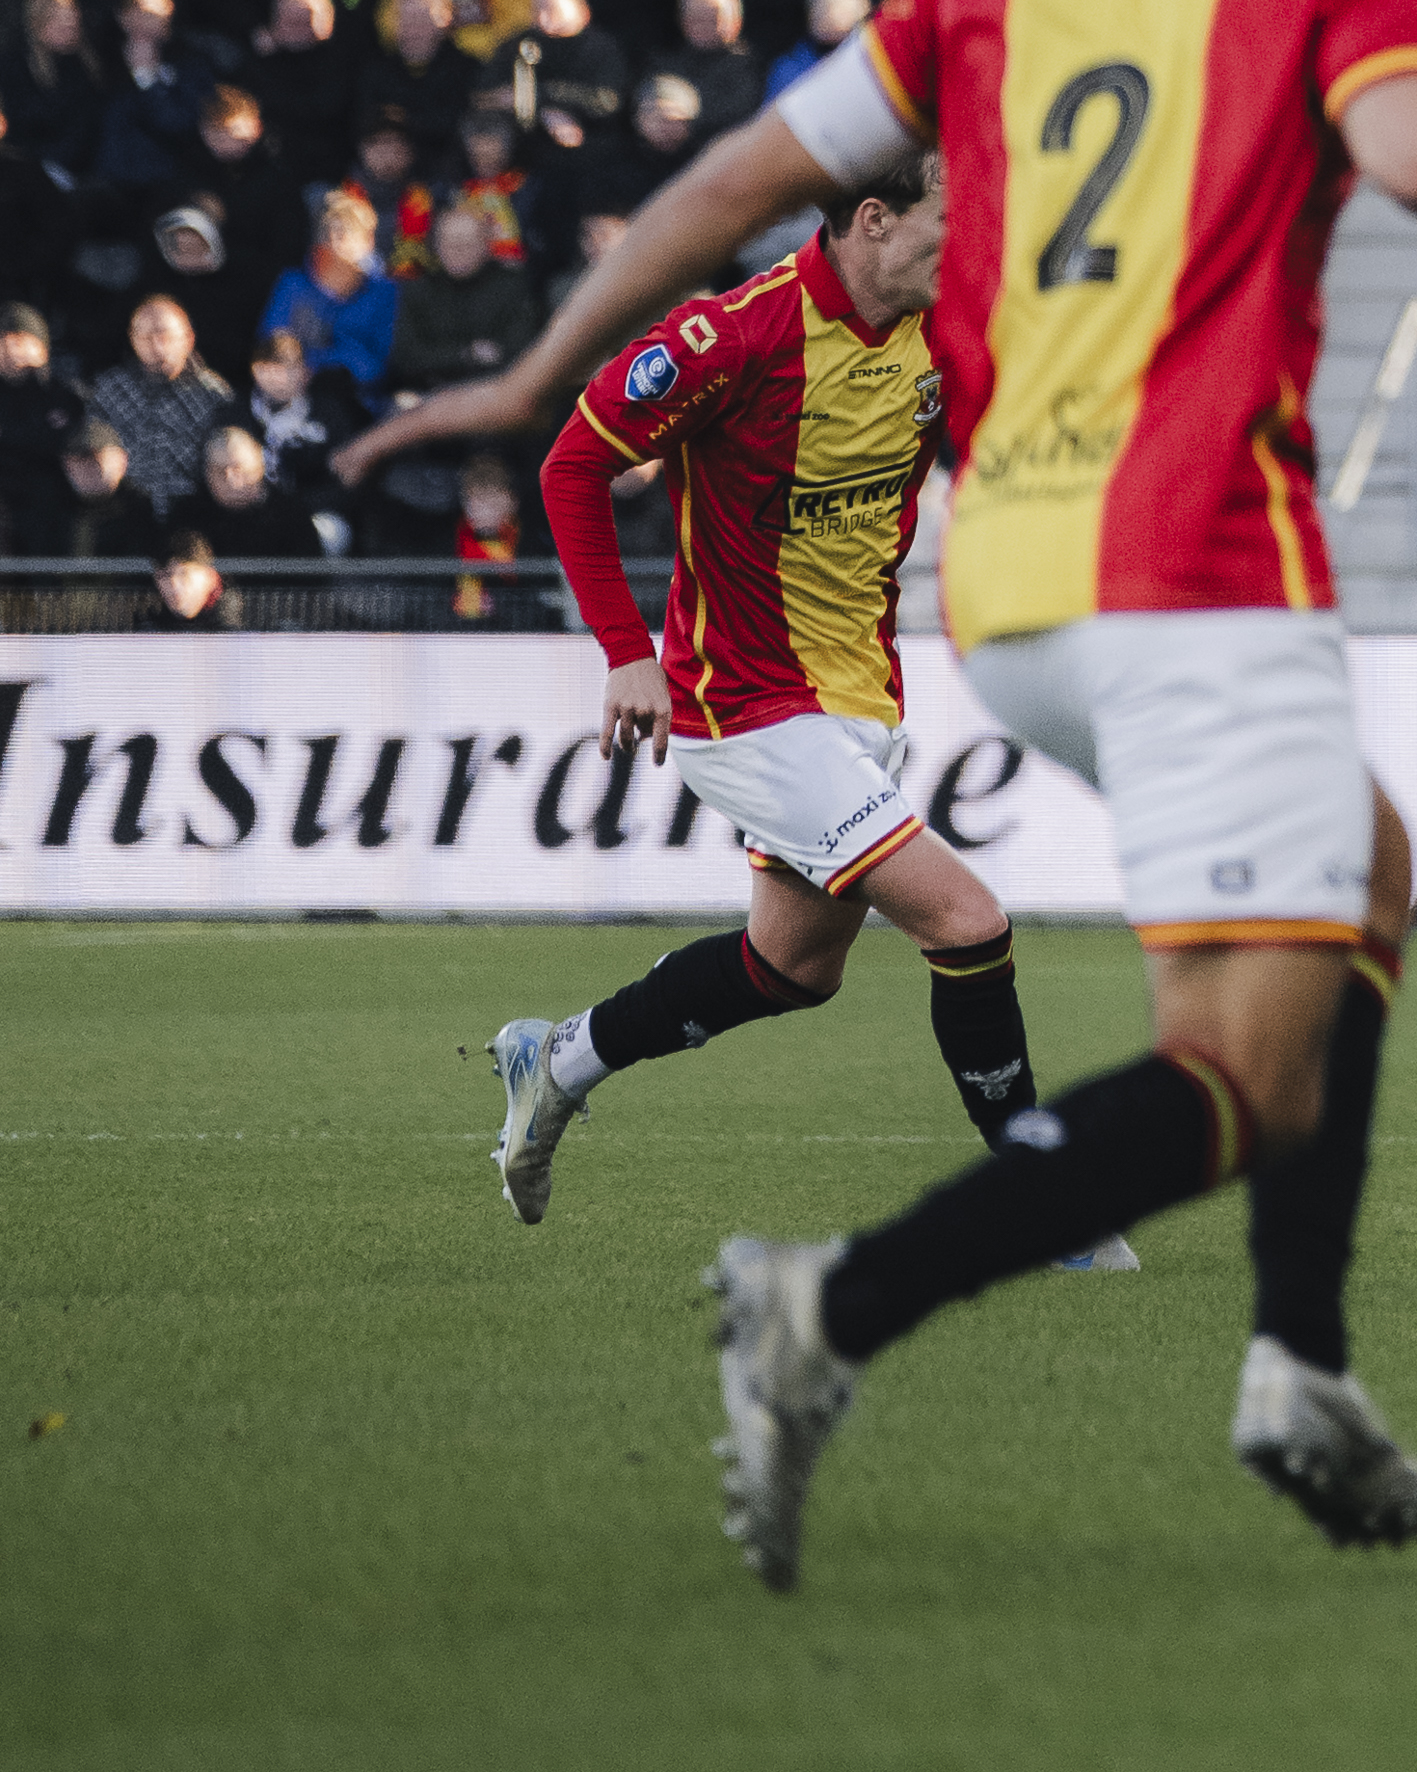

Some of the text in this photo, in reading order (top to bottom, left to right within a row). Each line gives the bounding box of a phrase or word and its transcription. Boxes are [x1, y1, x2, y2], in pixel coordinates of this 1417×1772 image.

[1036, 61, 1151, 292] 2
[847, 363, 902, 380] STANNO
[794, 470, 911, 518] RETRO
[810, 507, 883, 539] BRIDGE
[0, 679, 1025, 850] nsurae
[836, 795, 879, 837] maxi
